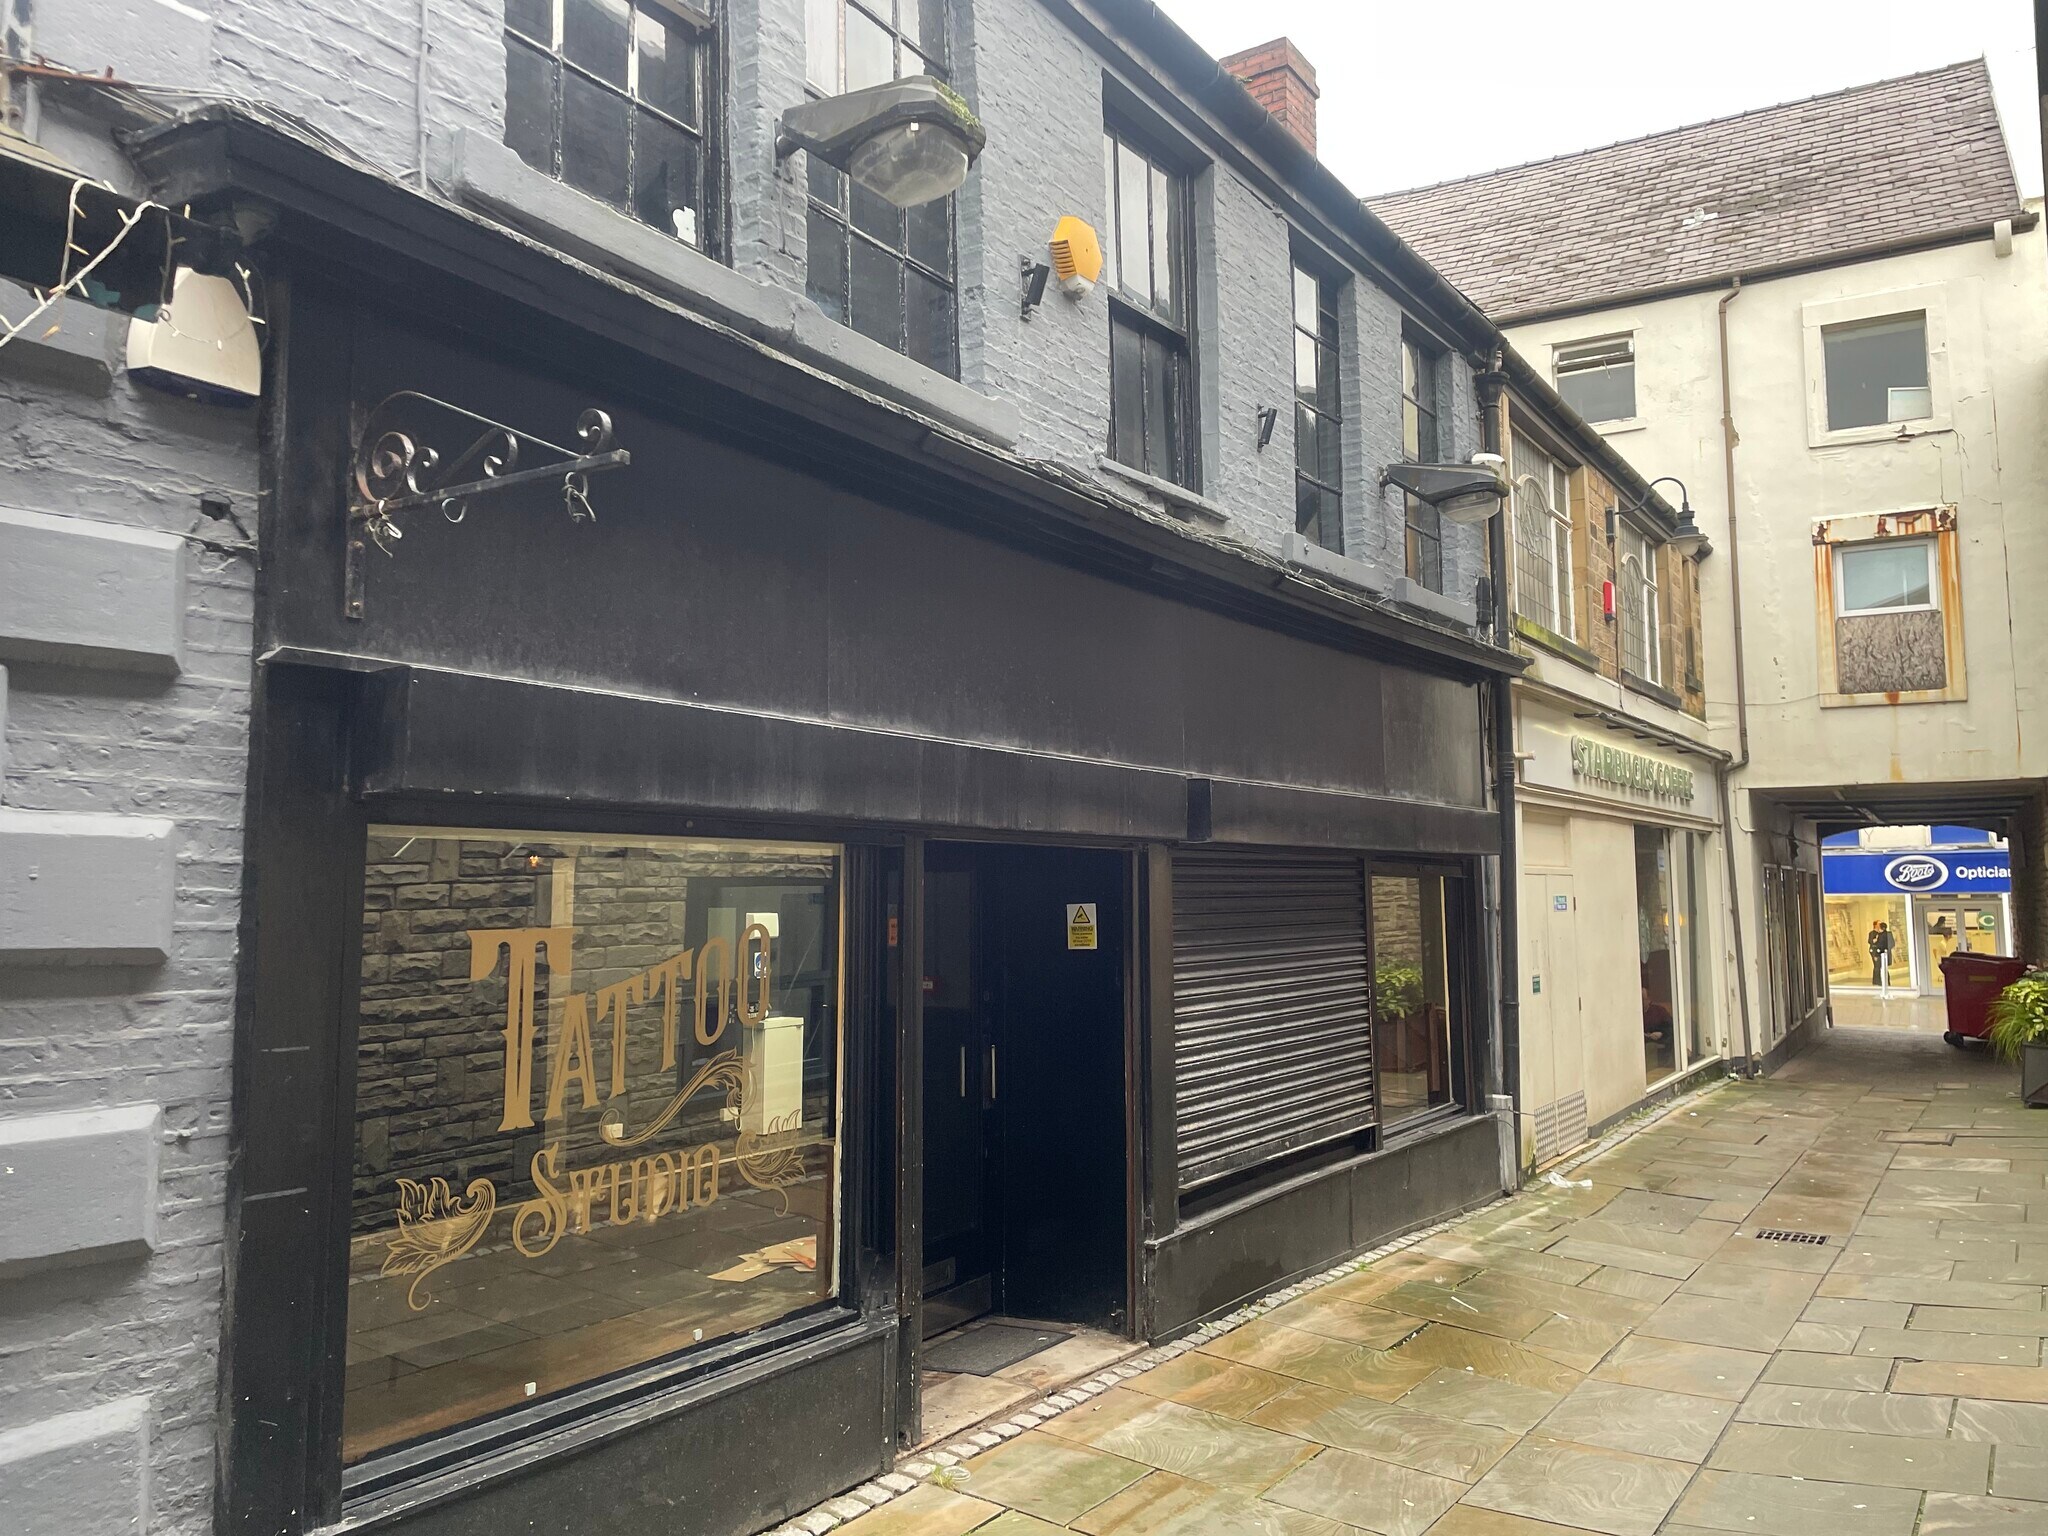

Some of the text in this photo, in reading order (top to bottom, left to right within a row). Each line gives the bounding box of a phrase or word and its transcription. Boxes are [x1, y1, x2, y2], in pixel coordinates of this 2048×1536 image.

[1571, 735, 1694, 801] STARBUCKS COFFEE
[1896, 864, 1935, 883] Boots
